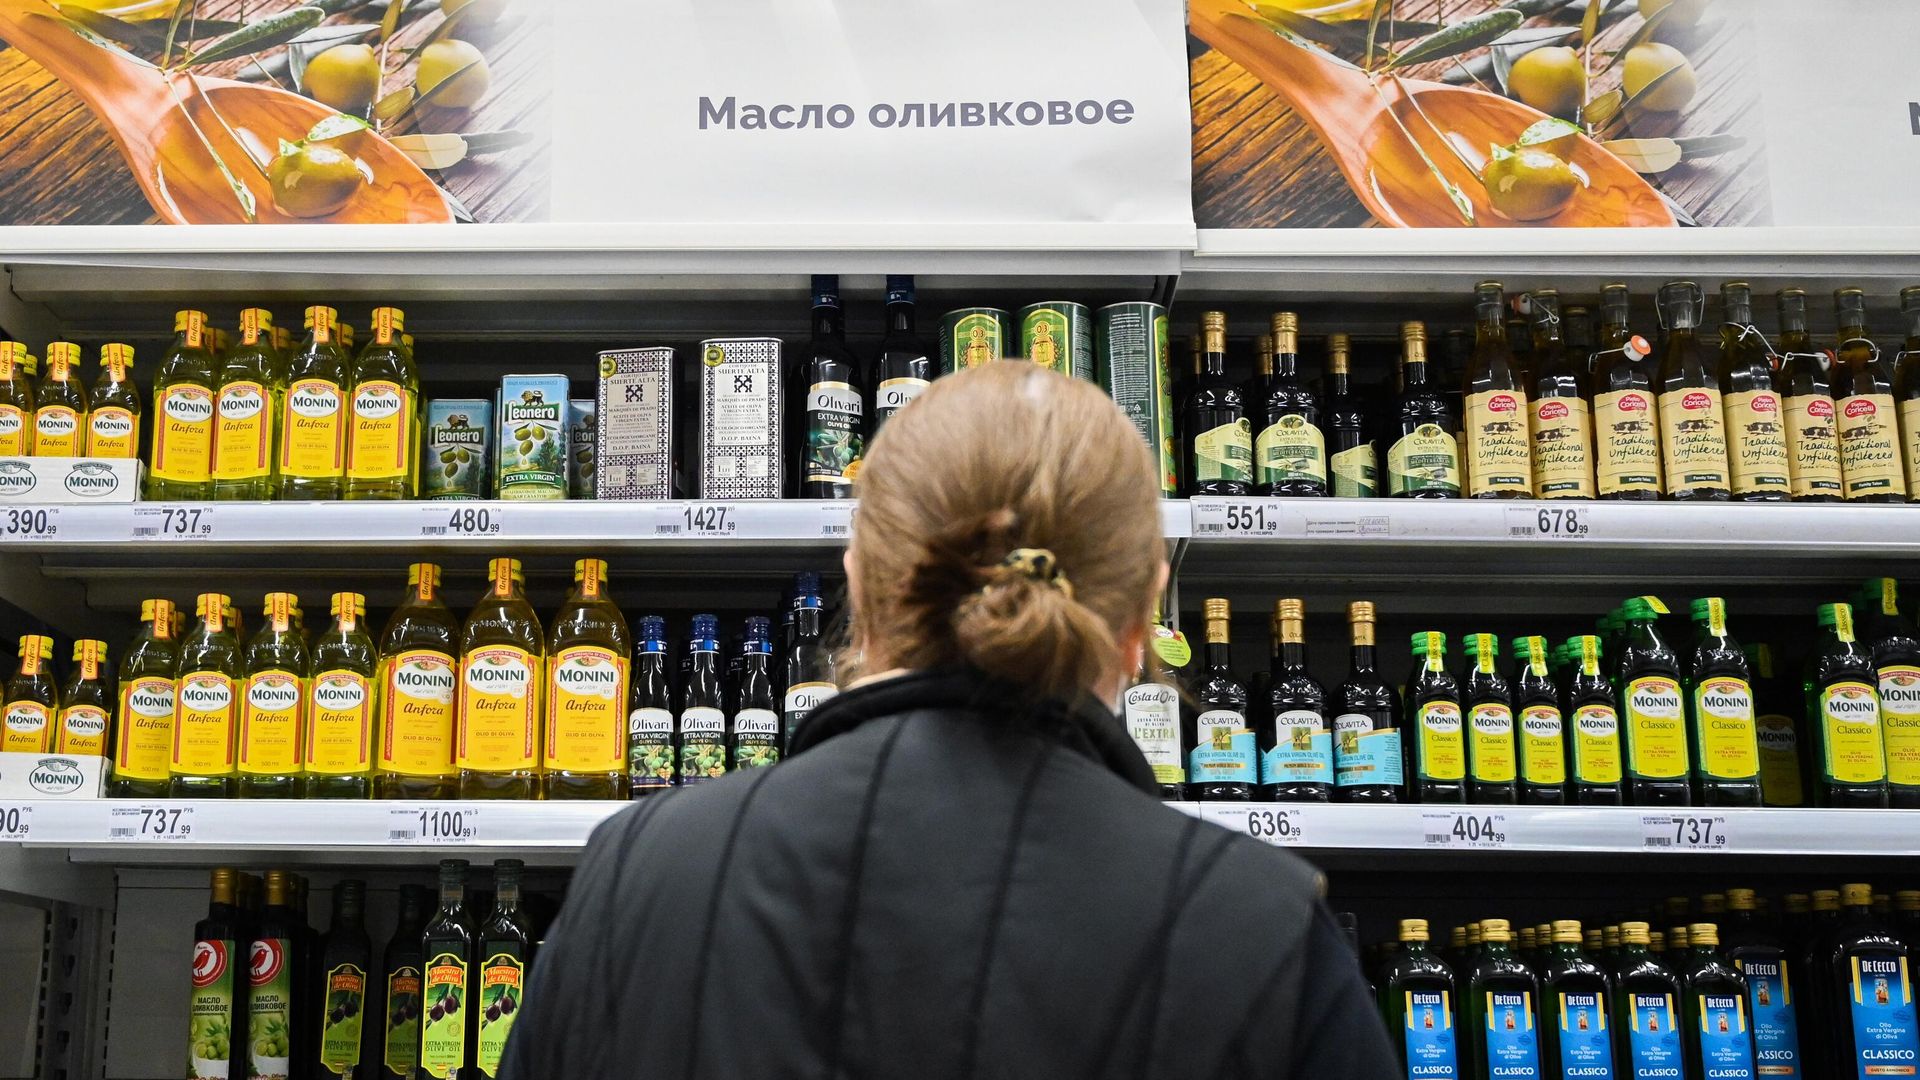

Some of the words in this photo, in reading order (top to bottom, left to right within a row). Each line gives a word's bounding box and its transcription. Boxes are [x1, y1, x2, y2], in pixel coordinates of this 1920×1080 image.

[699, 97, 856, 129] Масло
[868, 99, 1135, 128] оливковое
[746, 368, 765, 377] ALTA
[168, 400, 211, 415] MONINI
[222, 399, 260, 412] MONINI
[294, 397, 336, 409] MONINI
[357, 399, 398, 410] MONINI
[818, 394, 861, 413] Olivari
[1490, 401, 1516, 409] Coricelli
[508, 401, 555, 424] Leonero
[1540, 408, 1568, 417] Coricelli
[1846, 406, 1874, 415] Coricelli
[39, 419, 74, 430] MONINI
[296, 418, 331, 430] Anfora
[818, 412, 840, 421] EXTRA
[841, 414, 861, 425] VIRGIN
[95, 420, 131, 431] MONINI
[171, 422, 205, 435] Anfora
[222, 421, 255, 433] Anfora
[360, 420, 392, 431] Anfora
[41, 439, 69, 448] Anfora
[98, 440, 126, 449] Anfora
[1479, 436, 1528, 448] Traditional
[1673, 434, 1724, 447] Traditional
[1479, 448, 1529, 461] Unfiltered
[1674, 446, 1725, 461] Unfiltered
[1532, 454, 1585, 468] Unfiltered
[70, 478, 116, 488] MONINI
[7, 509, 47, 534] 390
[47, 525, 57, 534] 99
[162, 509, 202, 533] 737
[201, 525, 211, 533] 99
[449, 508, 490, 532] 480
[490, 523, 500, 532] 99
[684, 507, 727, 530] 1427
[728, 522, 735, 530] 99
[1227, 505, 1264, 530] 551
[1267, 521, 1277, 531] 99
[1538, 509, 1578, 533] 678
[1579, 525, 1588, 533] 99
[398, 672, 452, 689] MONINI
[470, 669, 525, 681] MONINI
[559, 669, 614, 682] MONINI
[184, 690, 229, 701] MONINI
[251, 689, 297, 700] MONINI
[317, 689, 361, 700] MONINI
[1128, 691, 1151, 705] Costa
[475, 698, 517, 712] Anfora
[566, 698, 607, 713] Anfora
[1634, 697, 1677, 708] MONINI
[1704, 697, 1748, 708] MONINI
[1830, 701, 1874, 713] MONINI
[403, 702, 444, 716] Anfora
[8, 715, 43, 726] MONINI
[187, 712, 222, 724] Anfora
[256, 711, 290, 724] Anfora
[320, 711, 355, 724] Anfora
[683, 717, 721, 730] Olivari
[1201, 716, 1240, 726] COLAVITA
[1280, 716, 1320, 726] COLAVITA
[1426, 715, 1460, 726] MONINI
[1475, 719, 1510, 728] MONINI
[68, 719, 104, 731] MONINI
[632, 718, 669, 730] Olivari
[738, 718, 776, 732] Olivari
[1525, 720, 1560, 730] MONINI
[1580, 719, 1615, 729] MONINI
[1640, 720, 1675, 730] Classico
[1711, 720, 1746, 730] Classico
[1134, 728, 1176, 739] L'EXTRA
[1837, 726, 1871, 735] Classico
[9, 734, 36, 743] Anfora
[70, 738, 97, 748] Anfora
[757, 733, 776, 741] VIRGIN
[1481, 736, 1508, 744] Classico
[1531, 739, 1557, 747] Classico
[34, 773, 79, 785] MONINI
[141, 809, 182, 834] 737
[181, 825, 191, 834] 99
[420, 811, 463, 837] 1100
[463, 828, 471, 837] 99
[1248, 811, 1290, 837] 636
[1291, 827, 1301, 836] 99
[19, 825, 29, 833] 99
[1453, 815, 1495, 841] 404
[1495, 833, 1505, 842] 99
[1672, 818, 1713, 844] 737
[1715, 835, 1726, 844] 99
[1863, 1050, 1915, 1060] CLASSICO
[1413, 1066, 1453, 1075] CLASSICO
[1494, 1067, 1534, 1076] CLASSICO
[1567, 1067, 1608, 1076] CLASSICO
[1638, 1068, 1679, 1077] CLASSICO
[1708, 1069, 1750, 1078] CLASSICO
